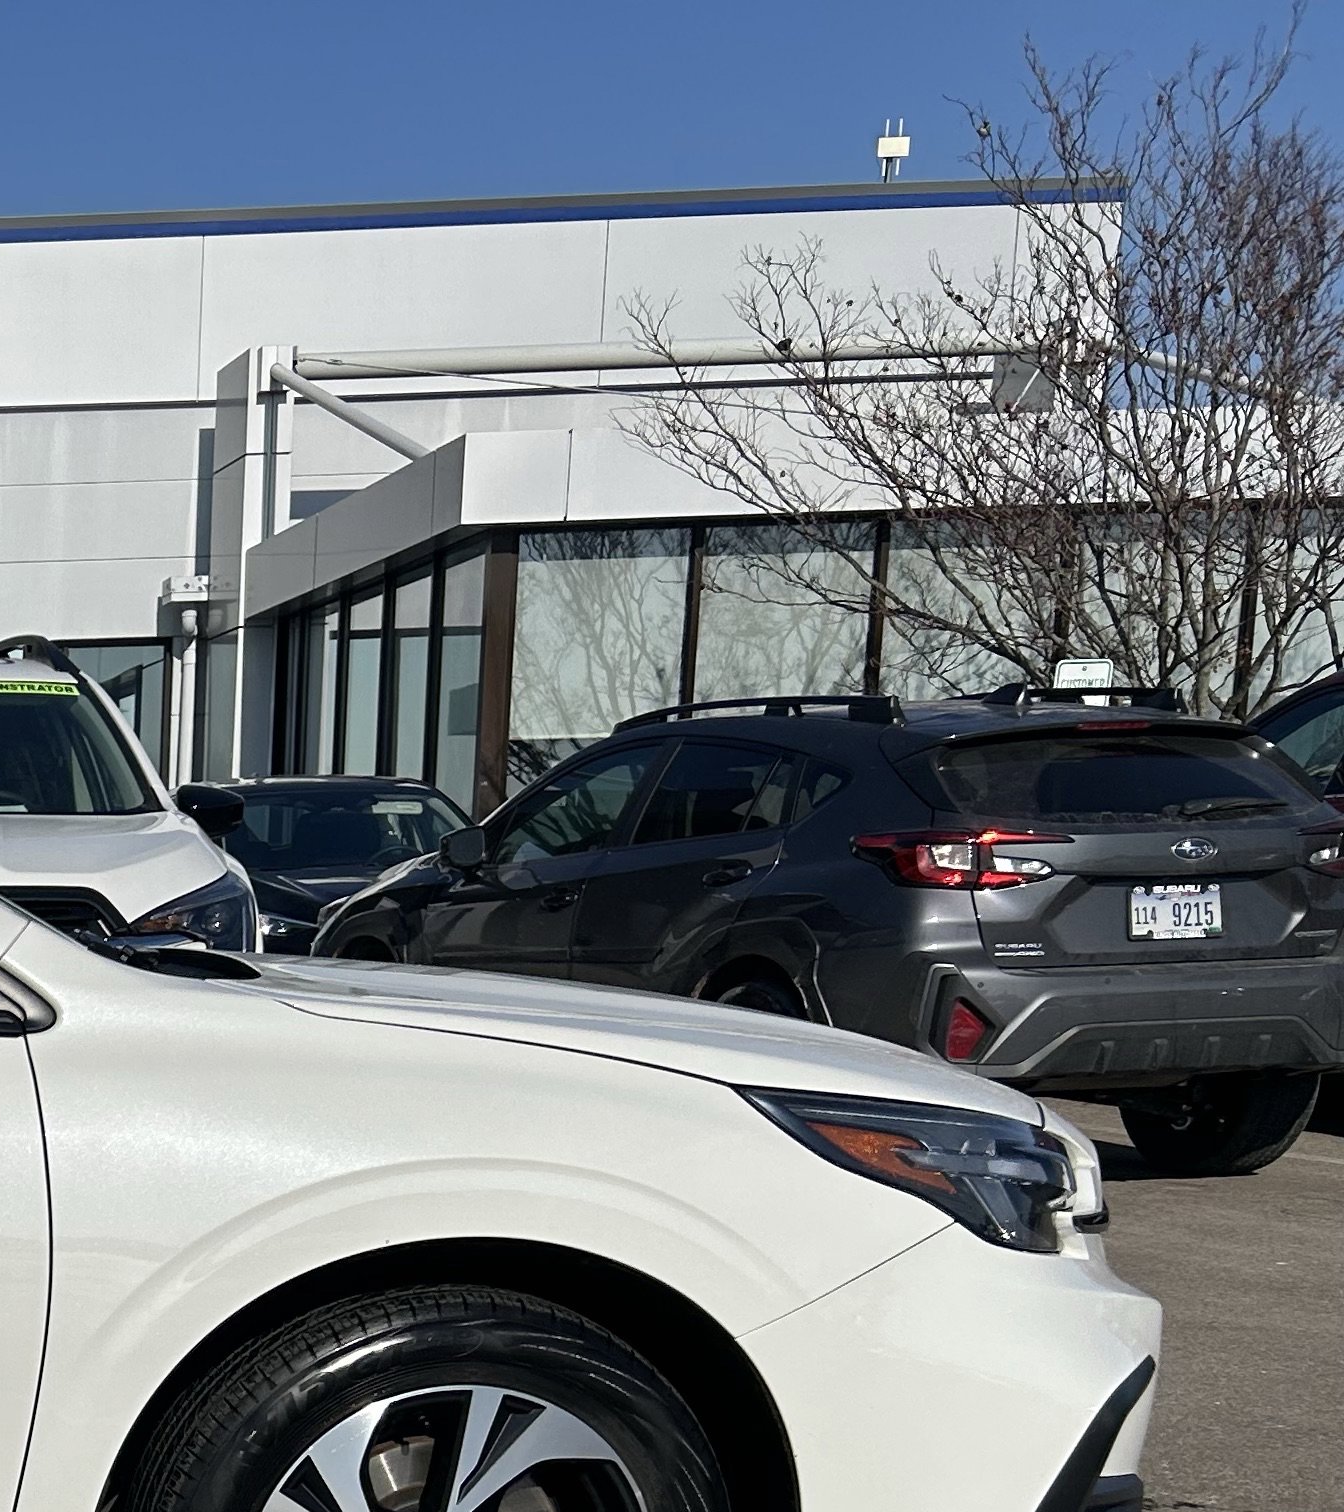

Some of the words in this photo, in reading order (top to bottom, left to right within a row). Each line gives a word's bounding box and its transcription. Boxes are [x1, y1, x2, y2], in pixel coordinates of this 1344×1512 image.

[1153, 884, 1201, 894] SUBARU
[1134, 906, 1157, 925] 114
[1172, 901, 1214, 927] 9215
